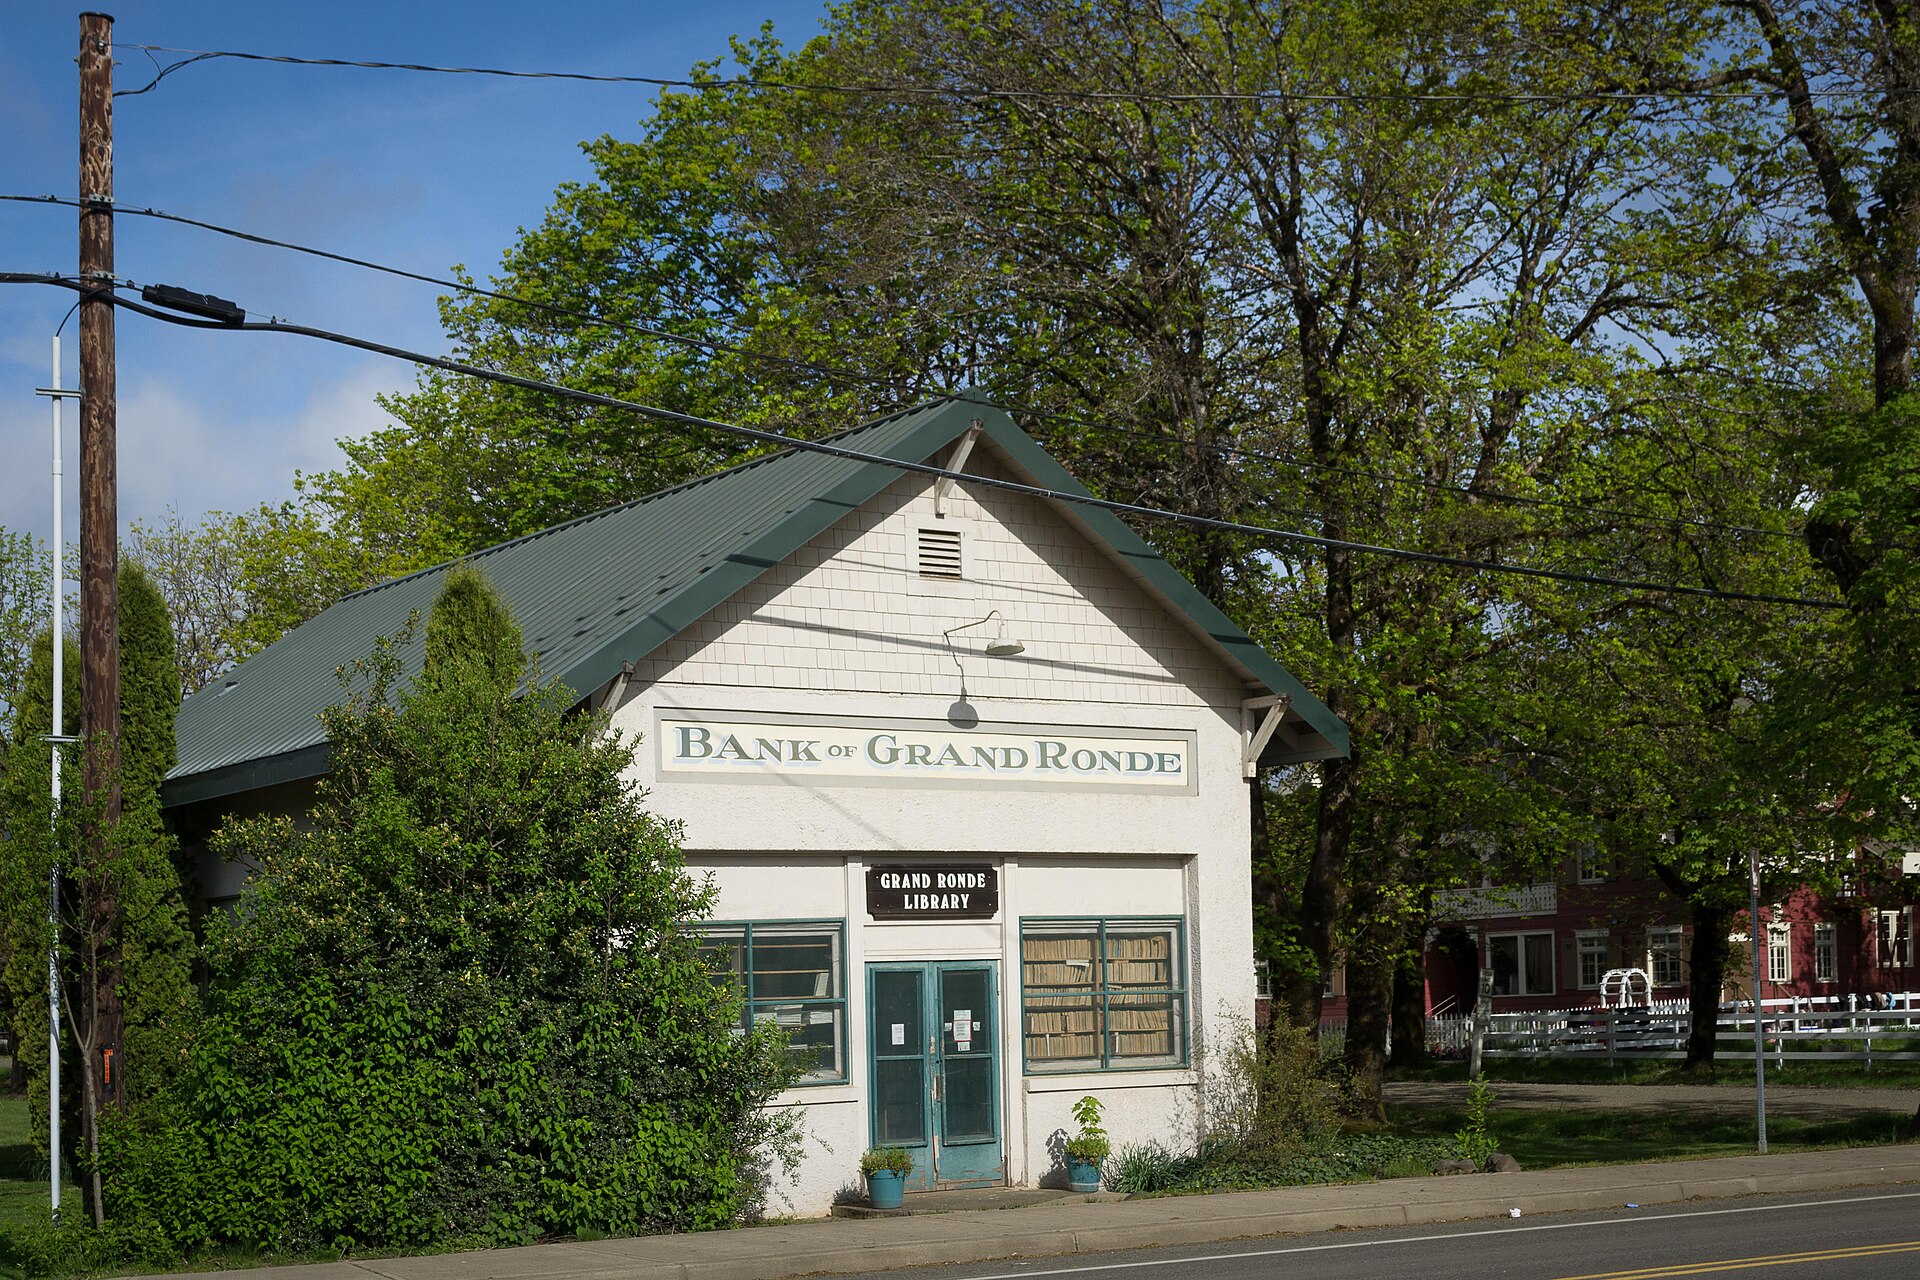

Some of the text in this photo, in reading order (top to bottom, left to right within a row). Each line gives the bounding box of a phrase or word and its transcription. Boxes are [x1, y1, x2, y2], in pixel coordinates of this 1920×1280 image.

[674, 725, 1182, 774] BANK OF GRAND RONDE
[880, 872, 986, 889] GRAND RONDE
[903, 893, 970, 910] LIBRARY
[1481, 983, 1490, 995] 10
